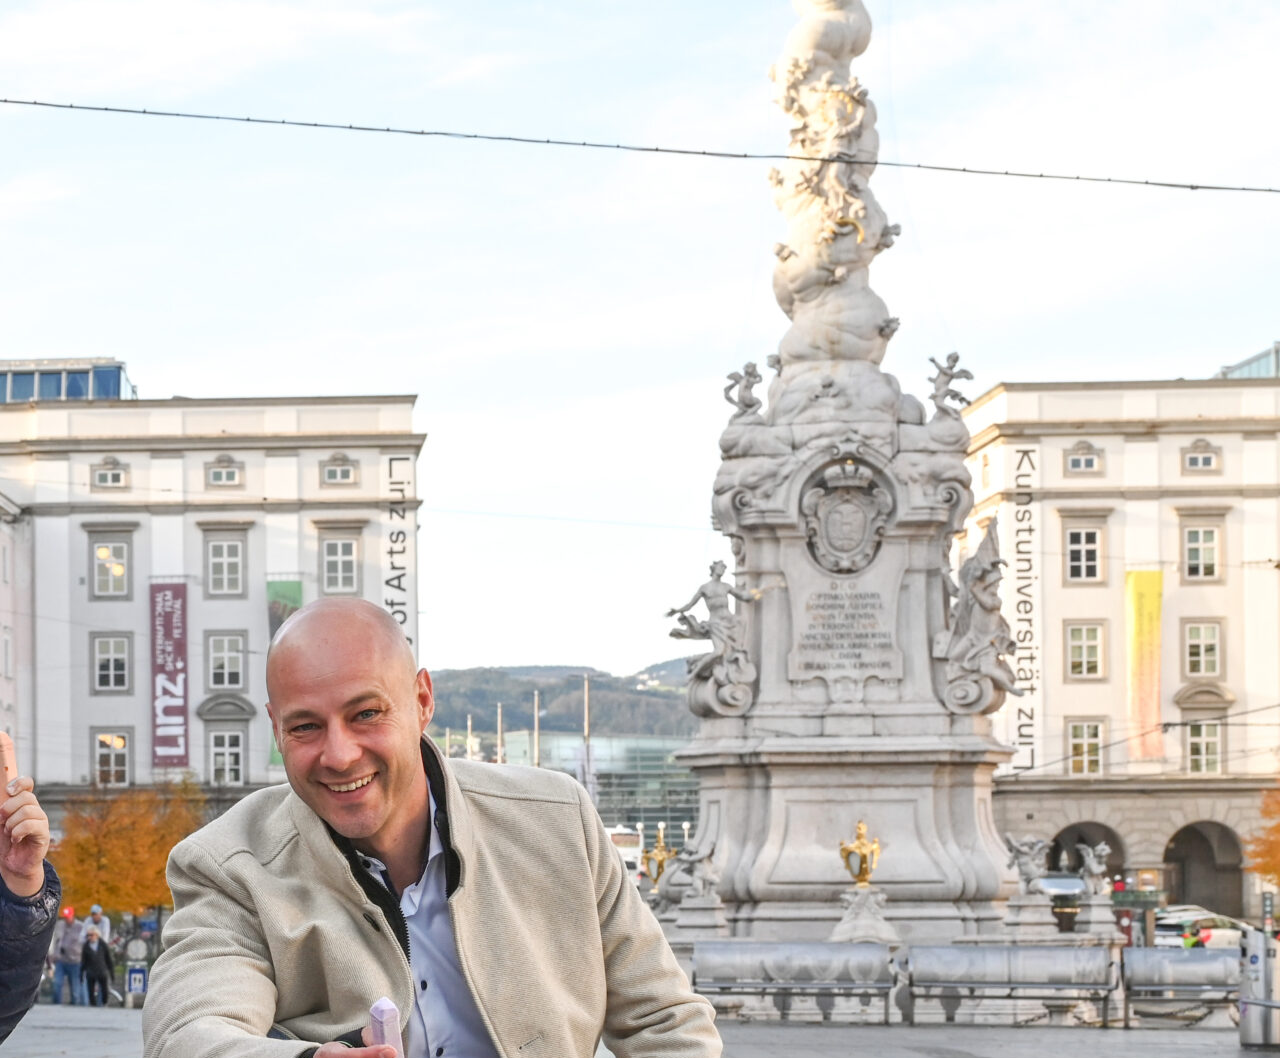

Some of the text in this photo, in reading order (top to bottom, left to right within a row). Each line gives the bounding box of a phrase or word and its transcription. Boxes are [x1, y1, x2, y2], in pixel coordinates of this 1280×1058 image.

[389, 457, 410, 520] Linz
[385, 530, 406, 592] Arts
[1015, 449, 1039, 695] Kunstuniversität
[164, 590, 173, 612] FILM
[1012, 707, 1035, 770] Linz
